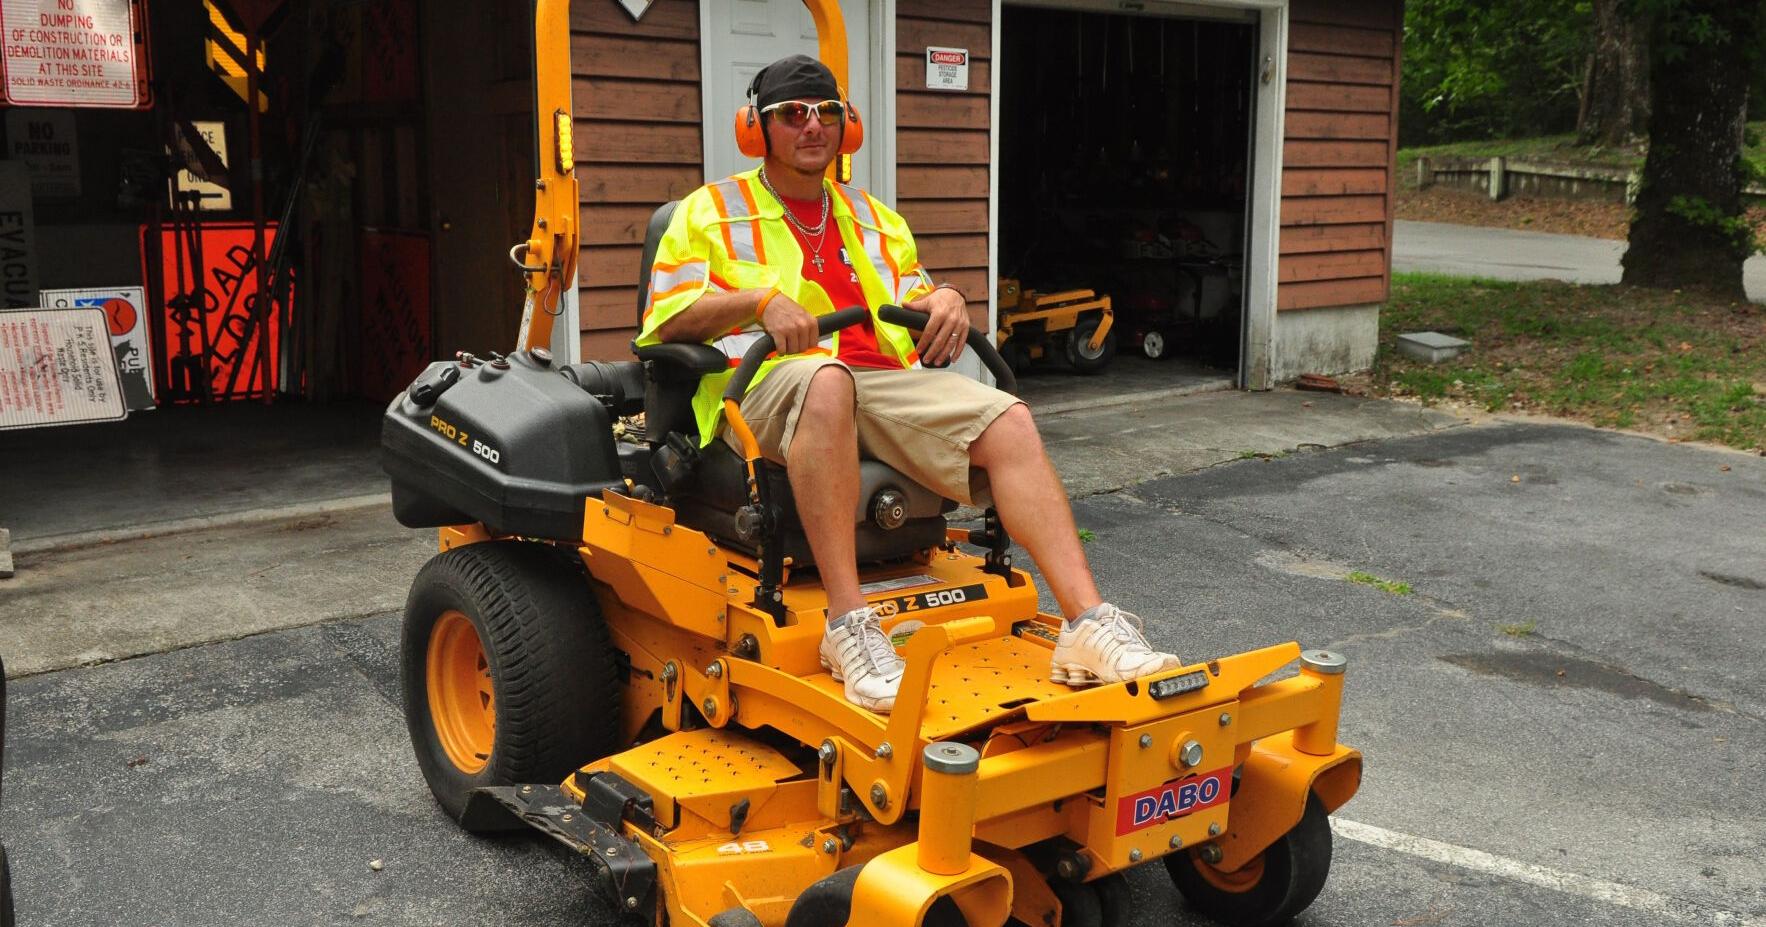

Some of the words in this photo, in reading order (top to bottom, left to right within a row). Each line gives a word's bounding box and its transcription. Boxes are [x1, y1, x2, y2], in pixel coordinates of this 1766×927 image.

[58, 0, 75, 10] NO
[40, 13, 94, 29] DUMPING
[12, 29, 25, 42] OF
[29, 30, 107, 46] CONSTRUCTION
[109, 34, 123, 46] OR
[7, 45, 70, 59] DEMOLITION
[72, 48, 129, 63] MATERIALS
[935, 53, 961, 63] DANGER
[38, 63, 52, 75] AT
[55, 63, 79, 76] THIS
[82, 65, 104, 77] SITE
[11, 77, 35, 86] SOLID
[37, 78, 64, 87] WASTE
[66, 79, 110, 89] ORDINANCE
[28, 121, 54, 140] NO
[15, 142, 70, 155] PARKING
[57, 348, 67, 367] Waste
[65, 338, 78, 373] Household
[72, 374, 83, 391] Solid
[80, 348, 92, 384] Residents
[87, 385, 96, 403] Only
[93, 366, 101, 376] for
[98, 392, 107, 403] by
[430, 415, 457, 440] PRO
[458, 431, 469, 447] Z
[472, 439, 501, 465] 500
[904, 596, 920, 611] Z
[925, 589, 966, 607] 500
[1133, 776, 1221, 826] DABO
[717, 840, 769, 853] 48
